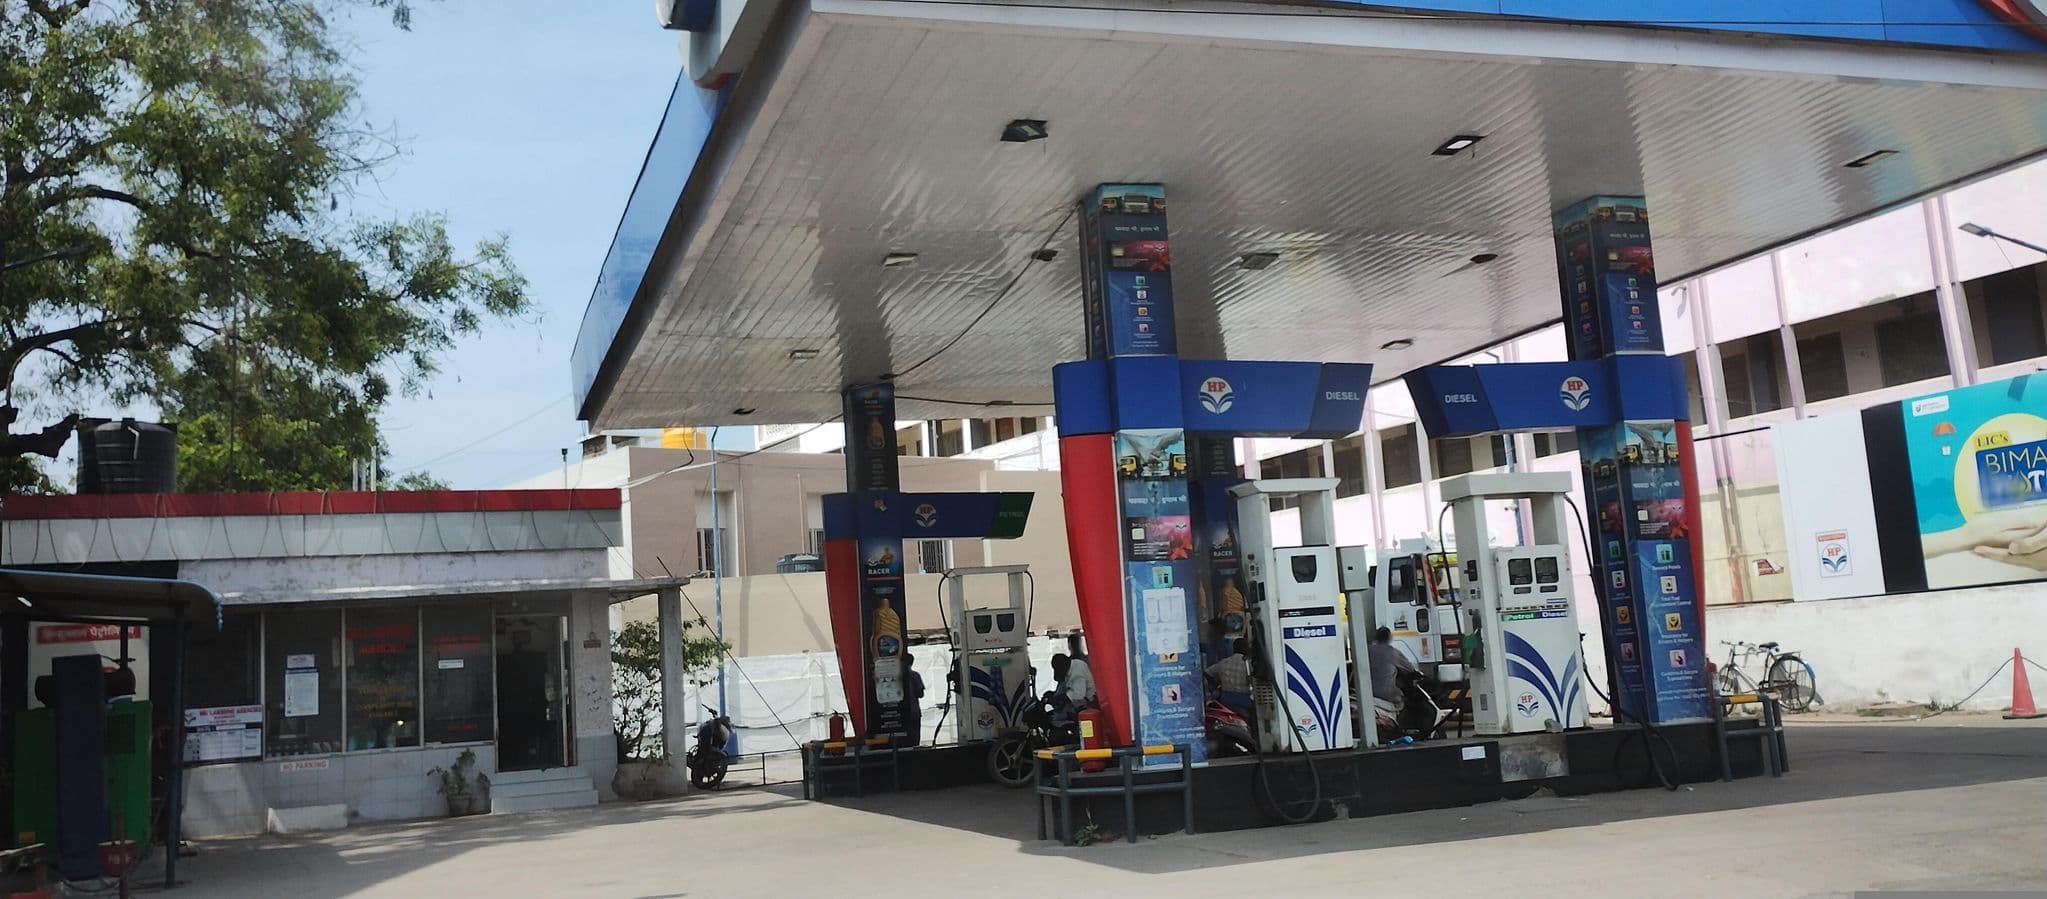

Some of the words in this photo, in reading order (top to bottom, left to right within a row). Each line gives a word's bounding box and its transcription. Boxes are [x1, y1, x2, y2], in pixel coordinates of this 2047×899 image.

[1207, 381, 1226, 392] HP
[1567, 380, 1584, 391] HP
[1325, 391, 1360, 400] DIESEL
[1444, 394, 1478, 403] DIESEL
[1977, 433, 2009, 447] LIC's
[1984, 445, 2047, 474] BIMA
[1827, 547, 1841, 557] HP
[1542, 610, 1568, 618] Diesel
[1293, 626, 1326, 637] Diesel
[1521, 695, 1533, 703] HP
[295, 760, 326, 769] PARKING
